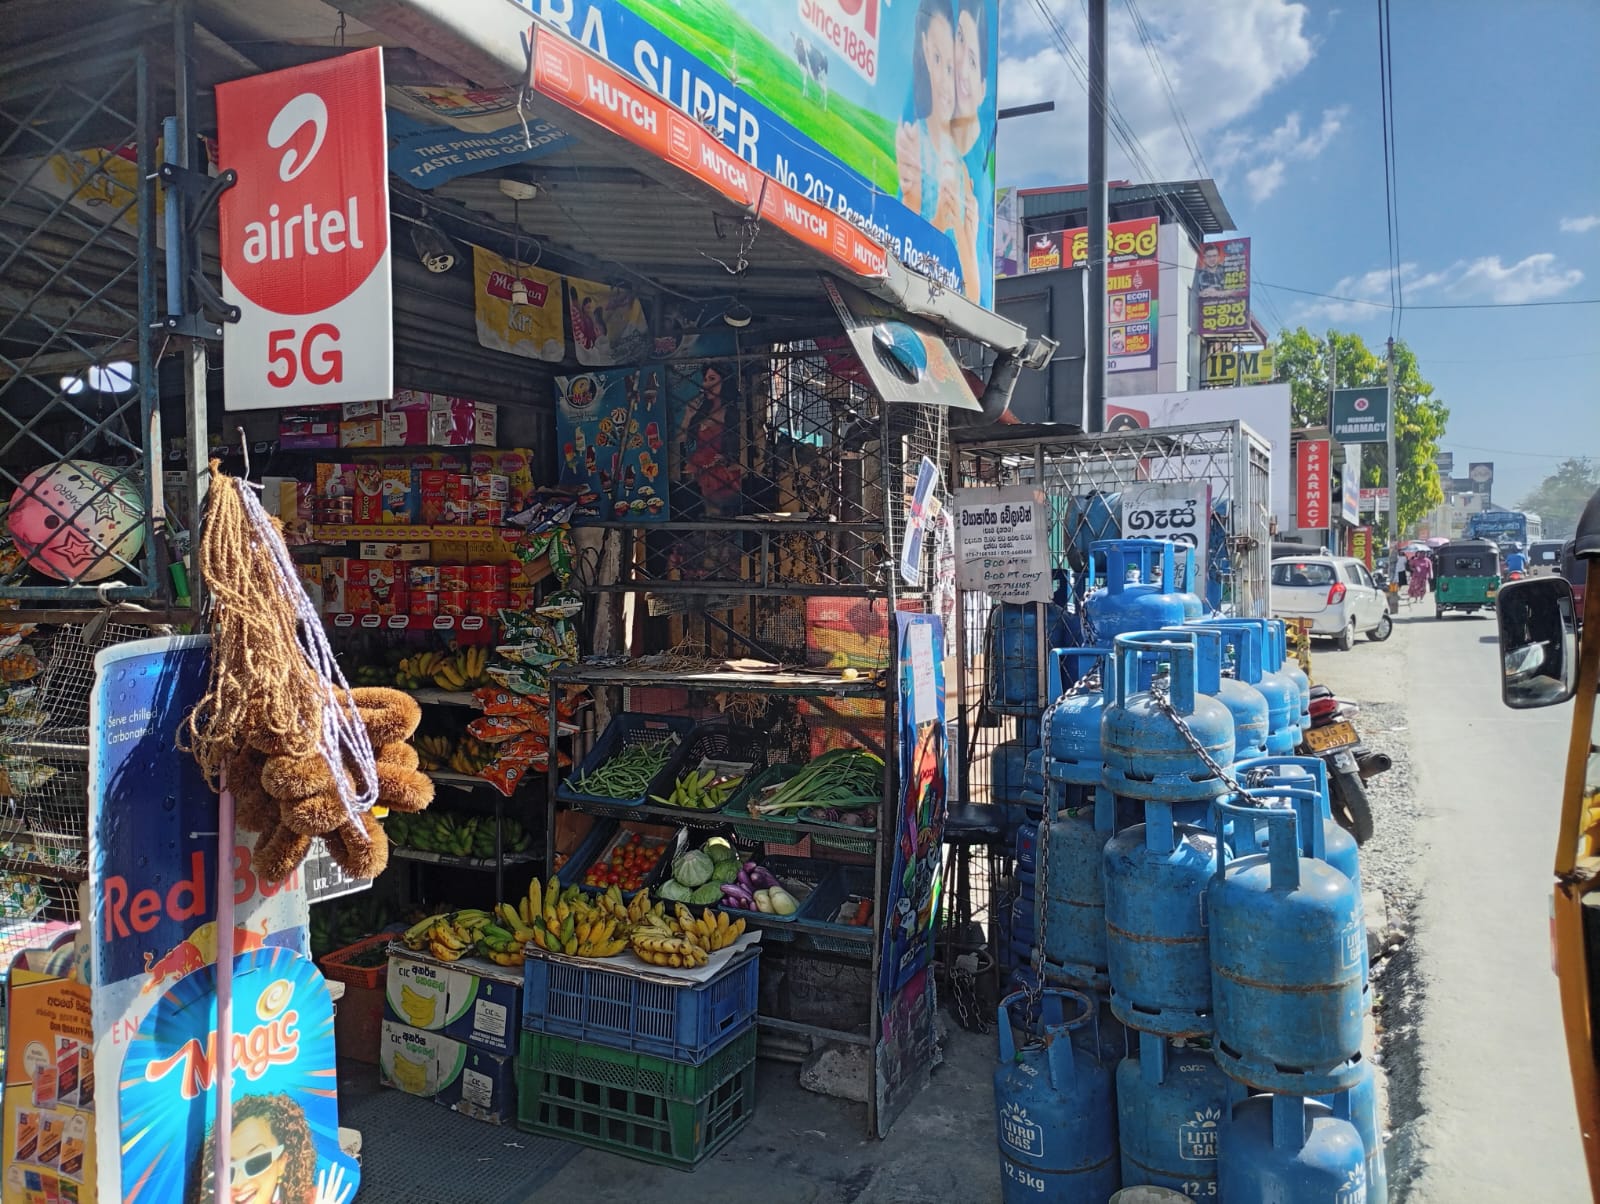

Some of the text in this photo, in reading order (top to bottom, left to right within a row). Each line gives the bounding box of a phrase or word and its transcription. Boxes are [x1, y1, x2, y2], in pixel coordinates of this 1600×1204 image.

[802, 0, 840, 47] Since
[843, 26, 874, 78] 1886
[529, 0, 760, 168] BA SUPER
[588, 74, 656, 134] HUTCH
[410, 153, 464, 177] TASTE
[464, 147, 501, 162] AND
[414, 143, 447, 157] THE
[702, 144, 749, 192] HUTCH
[804, 173, 834, 209] 207
[243, 197, 364, 264] airtel
[784, 199, 828, 239] HUTCH
[854, 240, 887, 275] HUTCH
[1127, 293, 1149, 301] ECON
[1127, 325, 1149, 333] ECON
[266, 322, 344, 388] 5G
[1210, 353, 1260, 378] IPM
[1336, 422, 1386, 434] PHARMACY
[1307, 453, 1322, 529] PHARMACY
[1022, 571, 1043, 582] ONLY
[108, 705, 158, 728] Serve chilled
[108, 722, 154, 745] Carbonated
[104, 850, 207, 943] Red
[399, 967, 411, 978] CIC
[391, 1033, 402, 1045] CIC
[144, 1011, 301, 1099] Magic
[1003, 1118, 1036, 1141] LITRO
[1007, 1132, 1032, 1151] GAS
[1187, 1132, 1217, 1145] LITR
[1004, 1161, 1045, 1193] 12.5kg
